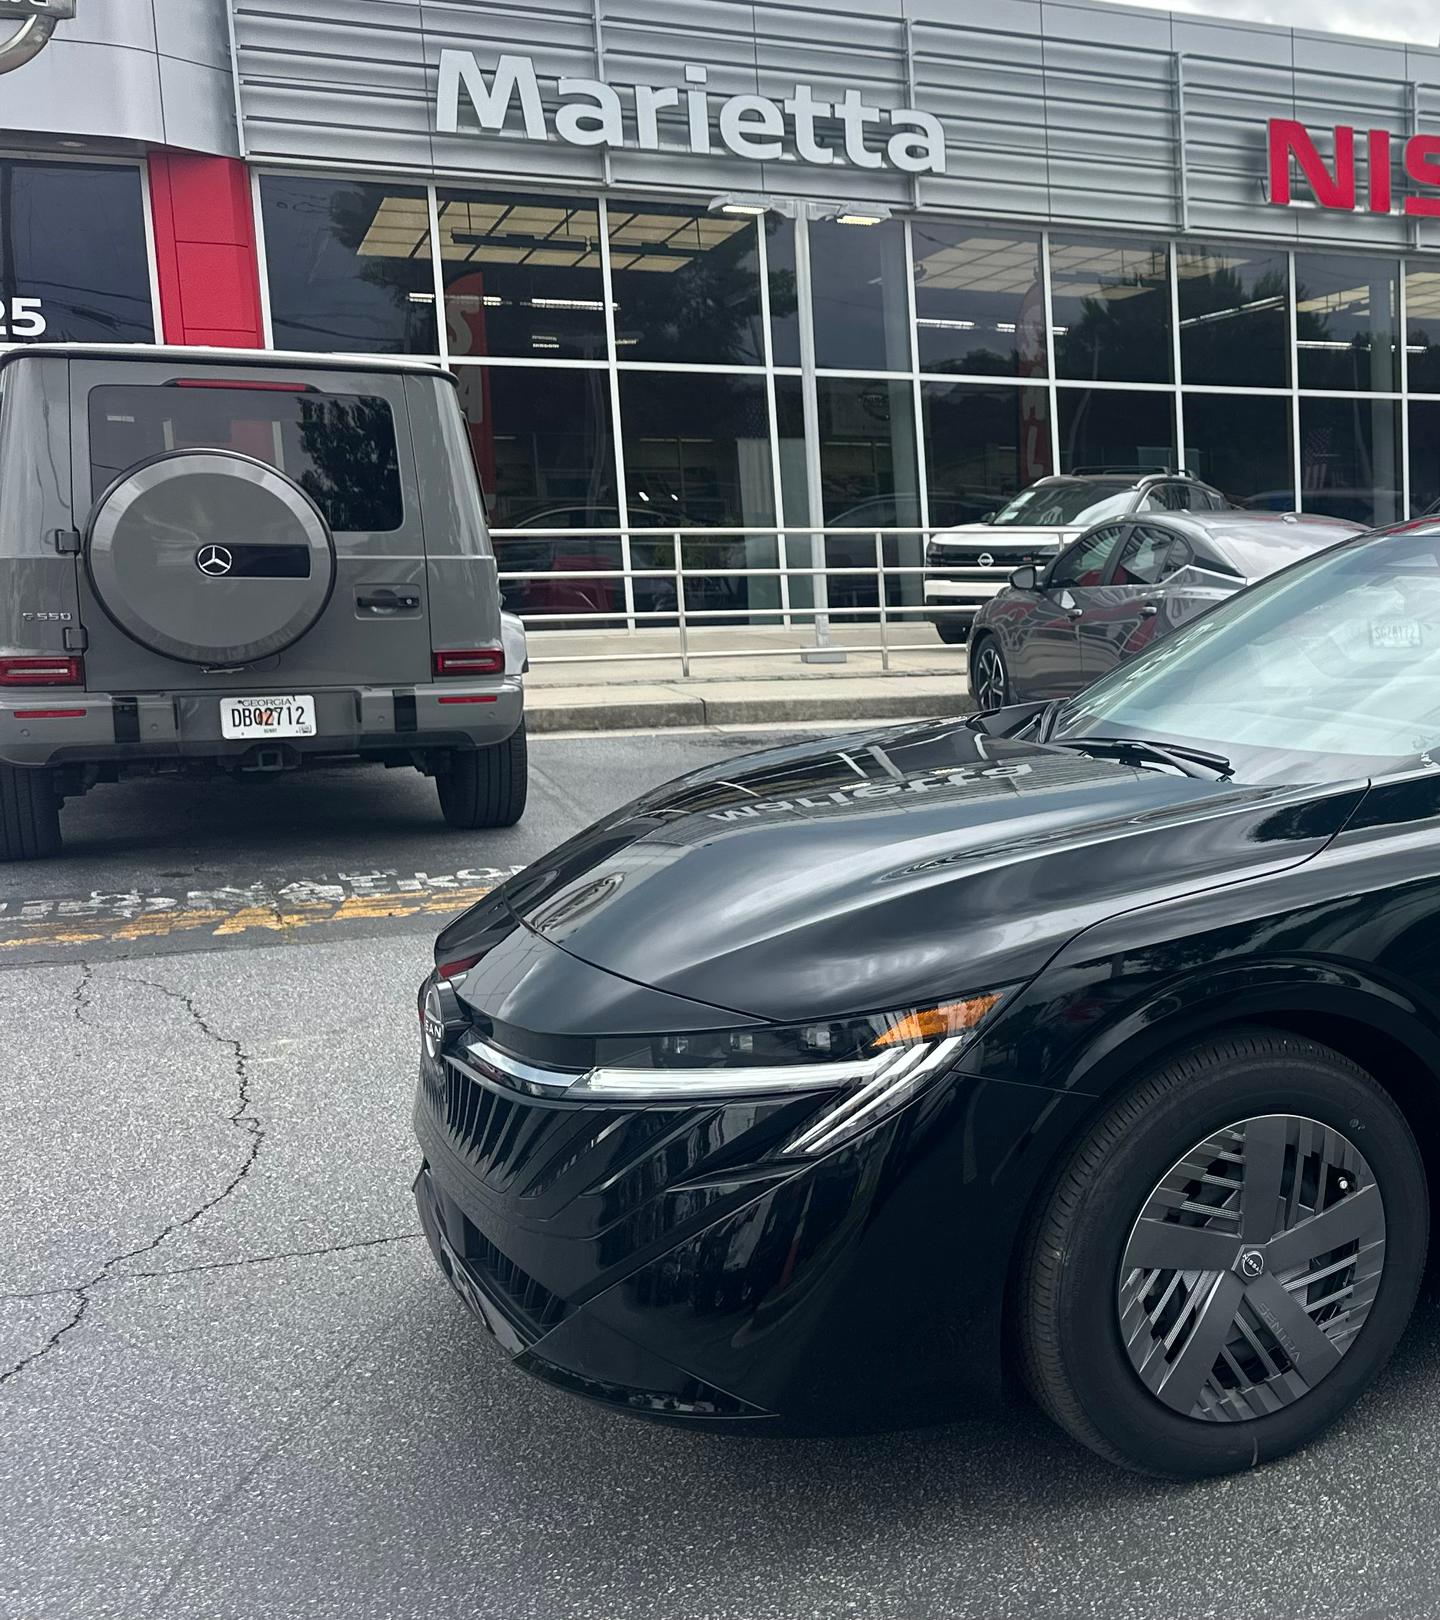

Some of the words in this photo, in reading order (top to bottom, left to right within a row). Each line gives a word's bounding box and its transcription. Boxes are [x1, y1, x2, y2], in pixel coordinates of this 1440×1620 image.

[436, 48, 947, 173] Marietta
[0, 296, 46, 337] 5
[241, 698, 293, 708] GEORGIA
[1256, 1302, 1301, 1363] SENTRA
